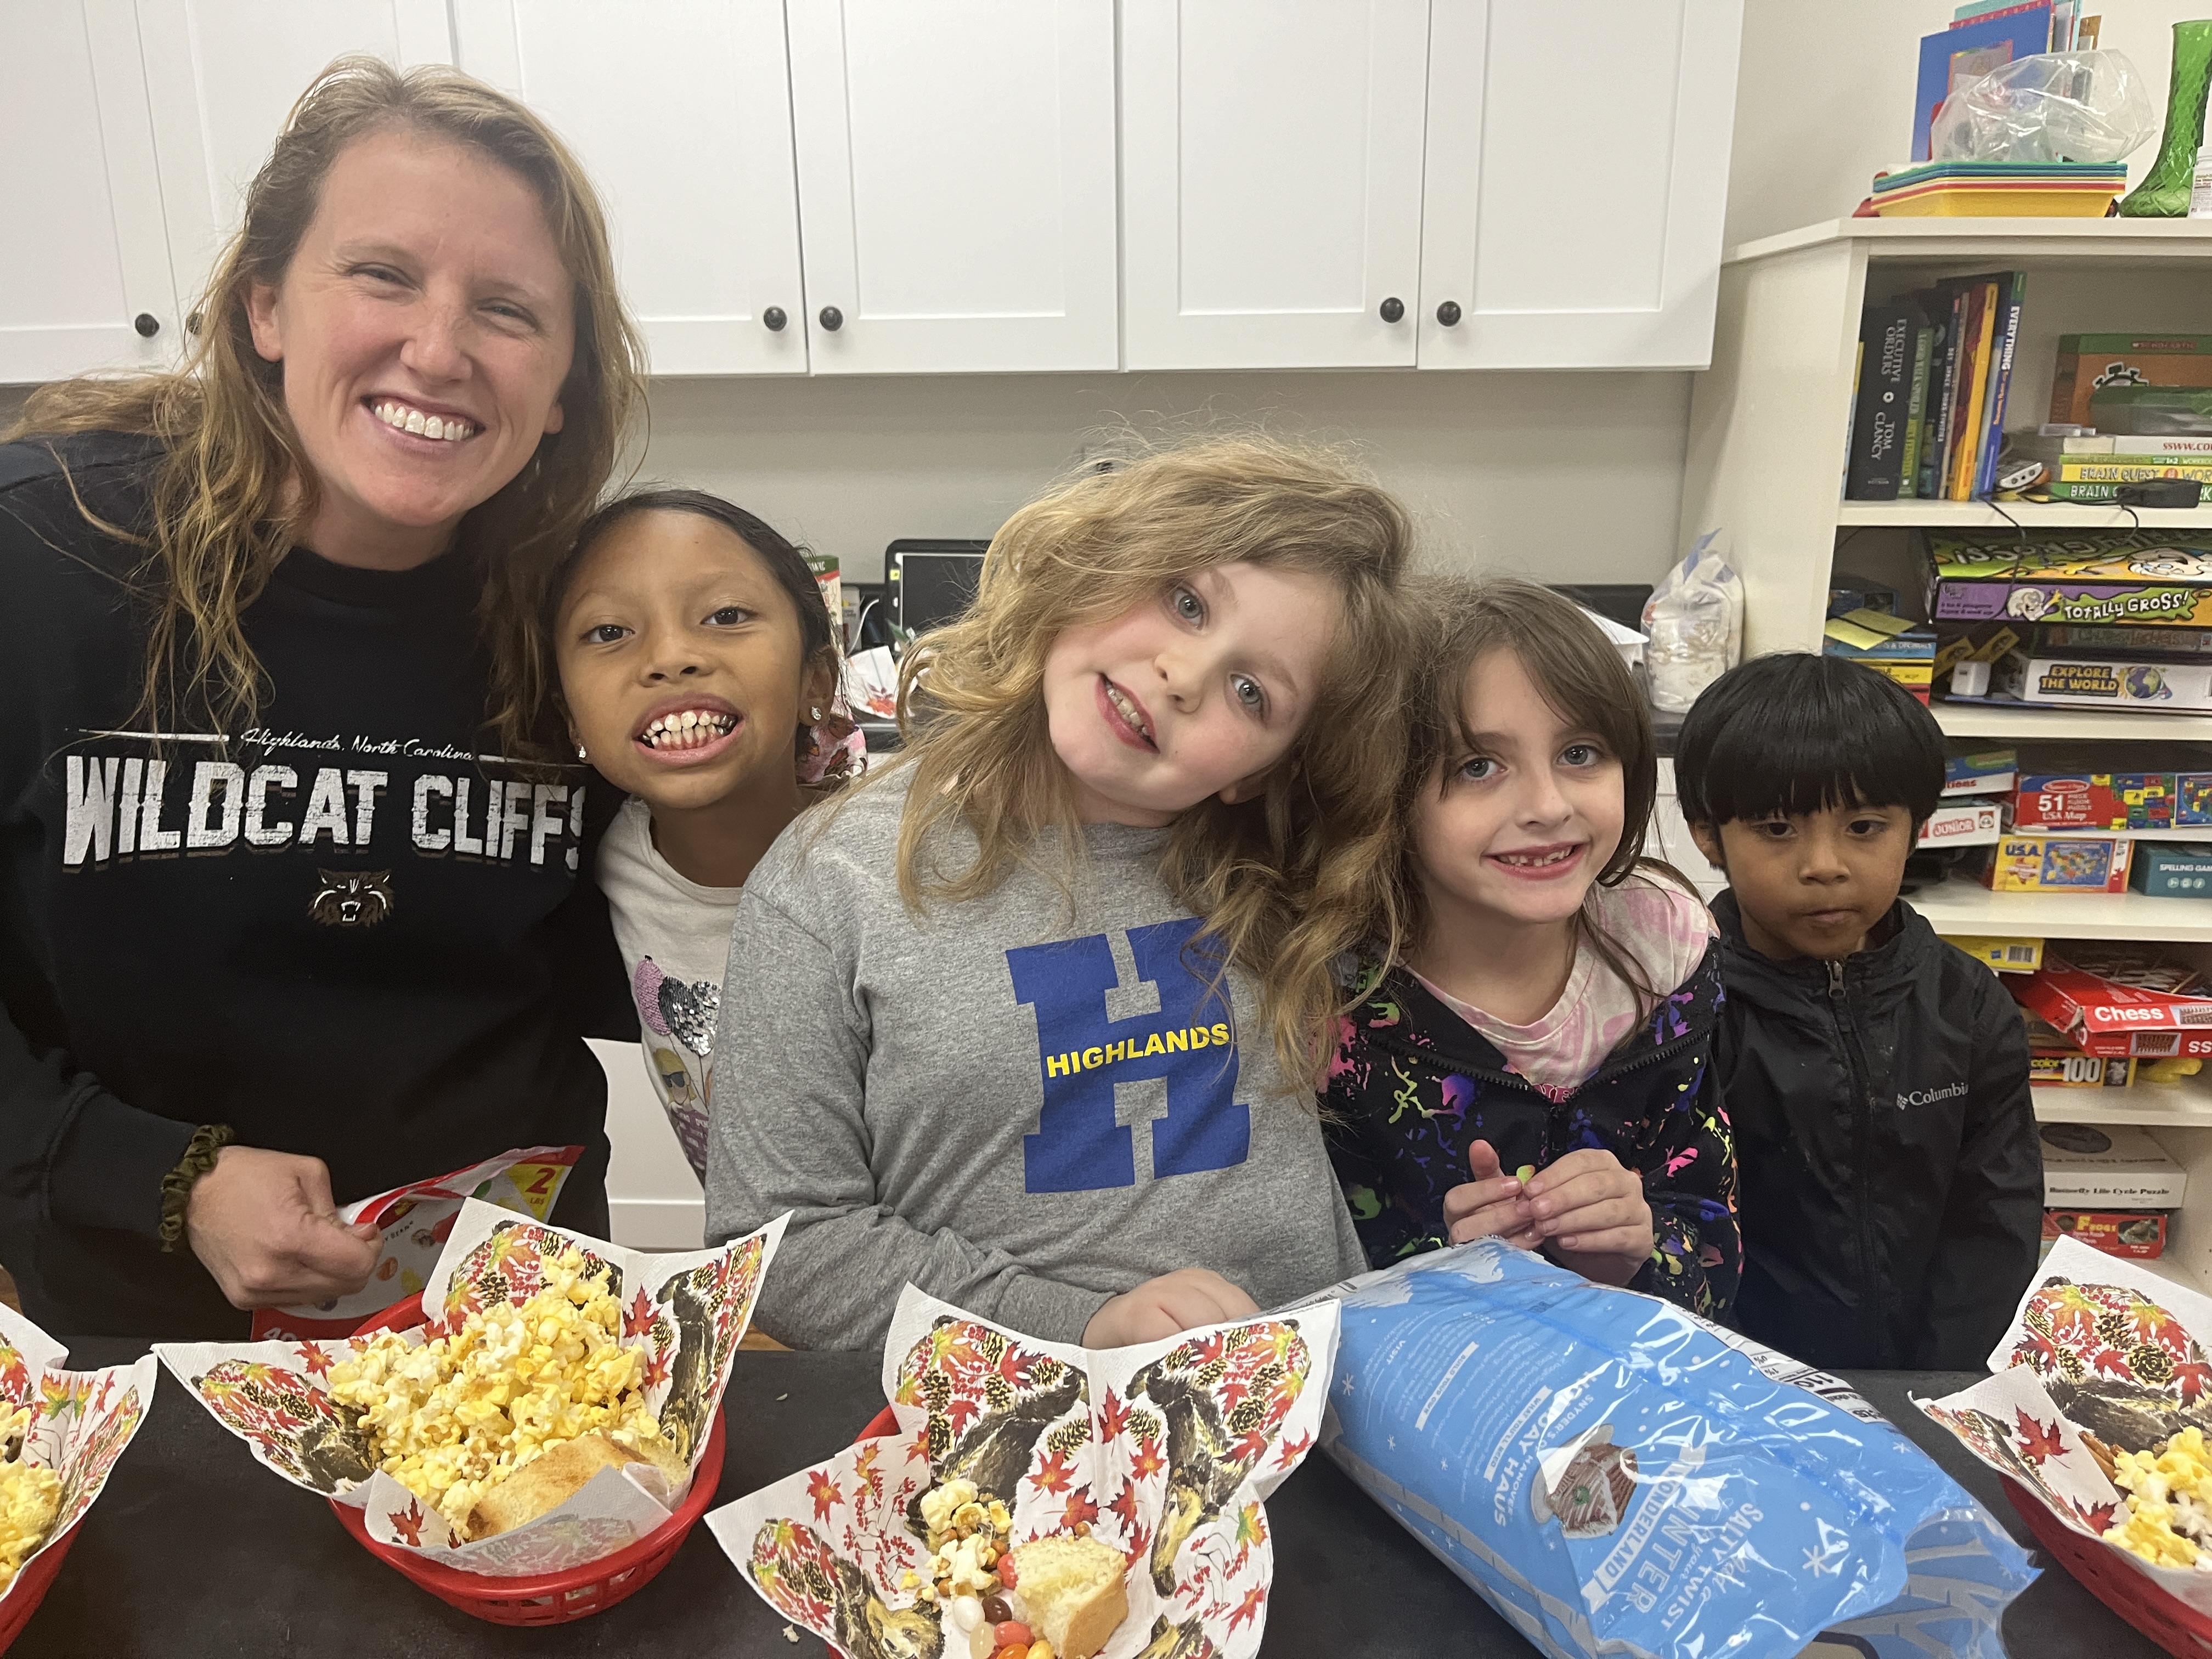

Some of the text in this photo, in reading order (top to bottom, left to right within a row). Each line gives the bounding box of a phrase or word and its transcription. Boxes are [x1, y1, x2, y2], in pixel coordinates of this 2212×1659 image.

[1881, 326, 1897, 375] ORDERS
[1891, 319, 1907, 382] EXECUTIVE
[1871, 412, 1886, 460] CLANCY
[1882, 421, 1895, 449] TOM
[2081, 467, 2119, 481] BRAIN
[2121, 467, 2160, 482] QUEST
[2071, 485, 2109, 498] BRAIN
[2065, 591, 2190, 619] TOTALLY GROSS!
[2041, 677, 2118, 691] THE WORLD
[2051, 667, 2110, 679] EXPLORE
[351, 735, 403, 754] North
[403, 738, 475, 761] Carolina
[63, 755, 388, 866] WILDCAT
[2038, 794, 2064, 812] 51
[2094, 1006, 2164, 1022] Chess
[1006, 916, 1251, 1193] H
[1047, 1023, 1230, 1078] HIGHLANDS
[2060, 1057, 2101, 1082] 100
[525, 1167, 556, 1194] 2
[1386, 1340, 1406, 1365] VISIT
[1793, 1375, 1834, 1388] 110
[1522, 1398, 1541, 1418] WHAT
[1546, 1394, 1593, 1440] SNYDER'S
[1492, 1457, 1519, 1526] HAUS
[1660, 1502, 1764, 1632] SALTY TWIST
